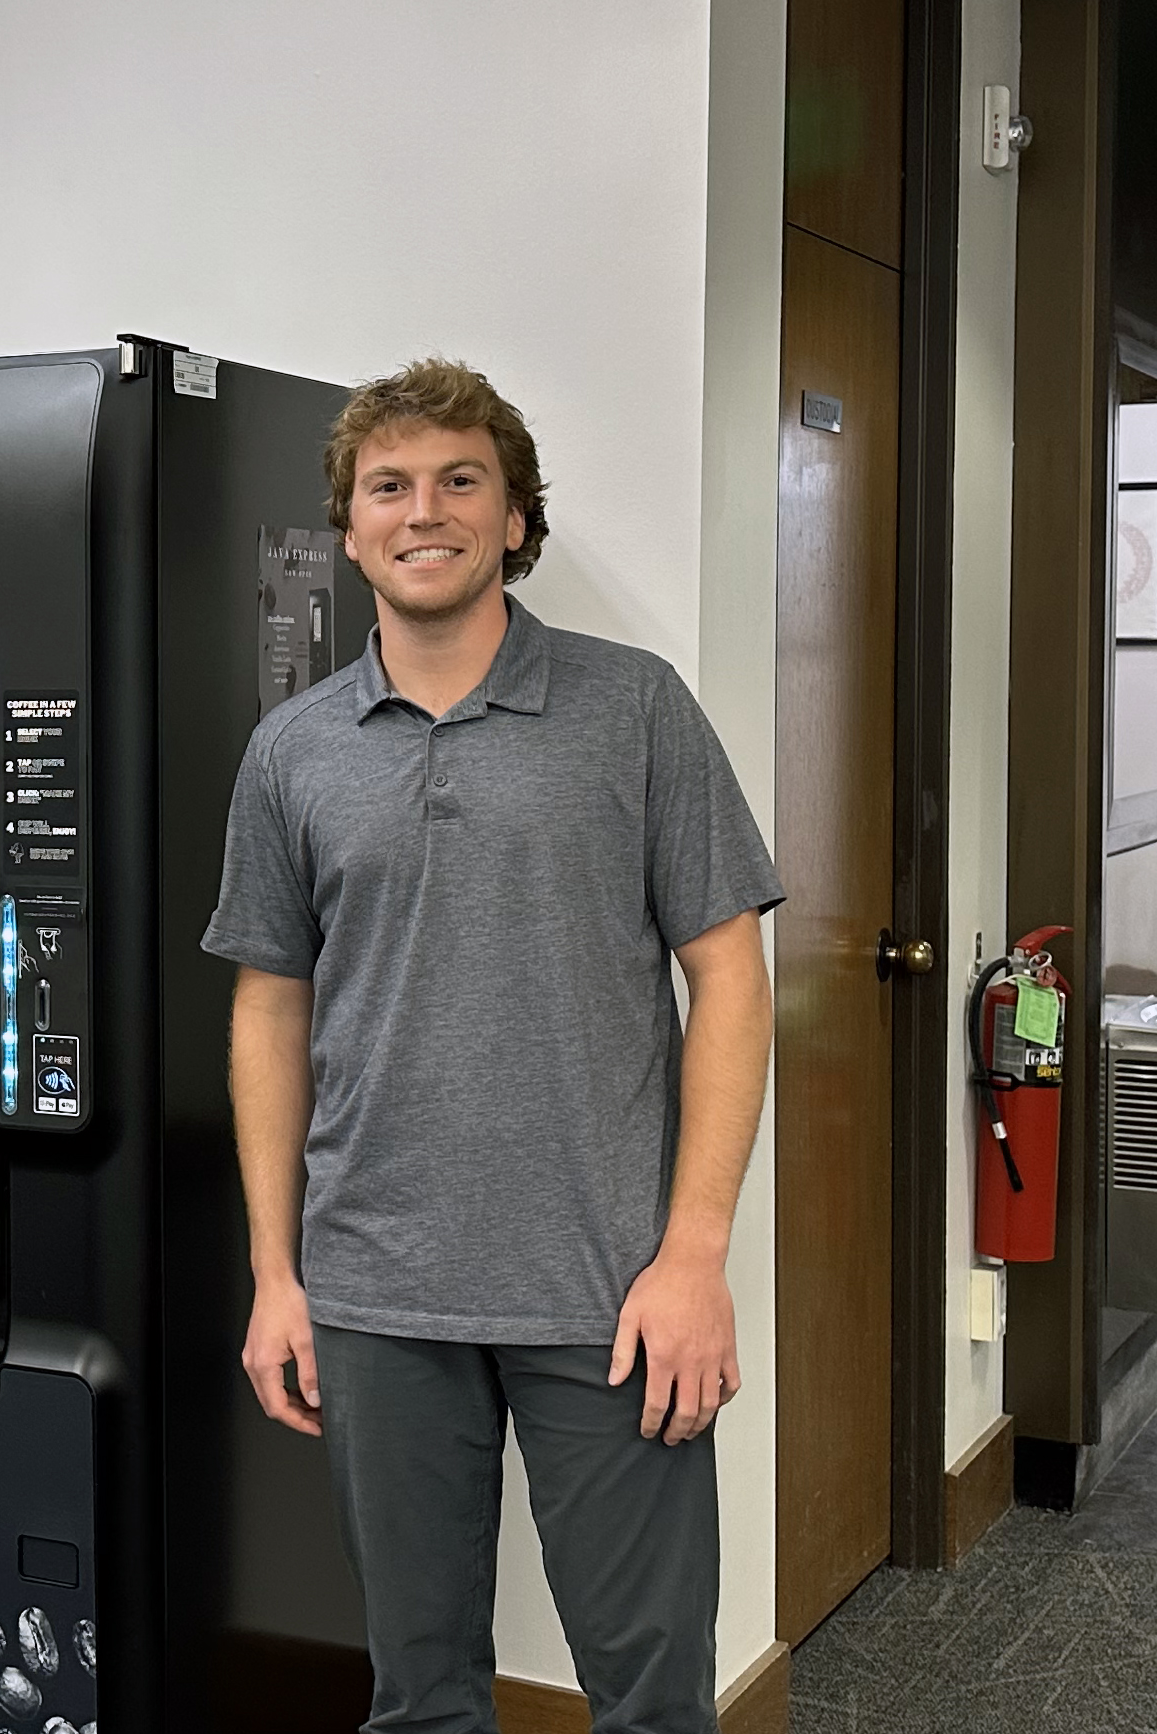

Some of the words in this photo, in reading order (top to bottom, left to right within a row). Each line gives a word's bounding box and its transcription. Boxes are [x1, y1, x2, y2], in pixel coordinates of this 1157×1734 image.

[267, 547, 290, 560] JAVA
[293, 548, 328, 563] EXPRESS
[7, 700, 38, 709] COFFEE
[39, 700, 49, 709] IN
[49, 700, 56, 709] A
[57, 700, 77, 709] FEW
[11, 709, 43, 718] SIMPLE
[44, 709, 71, 718] STEPS
[6, 730, 13, 742] 1
[17, 728, 43, 736] SELECT
[6, 761, 14, 773] 2
[6, 791, 14, 803] 3
[6, 822, 15, 833] 4
[39, 1054, 53, 1063] TAP
[54, 1055, 72, 1065] HERE
